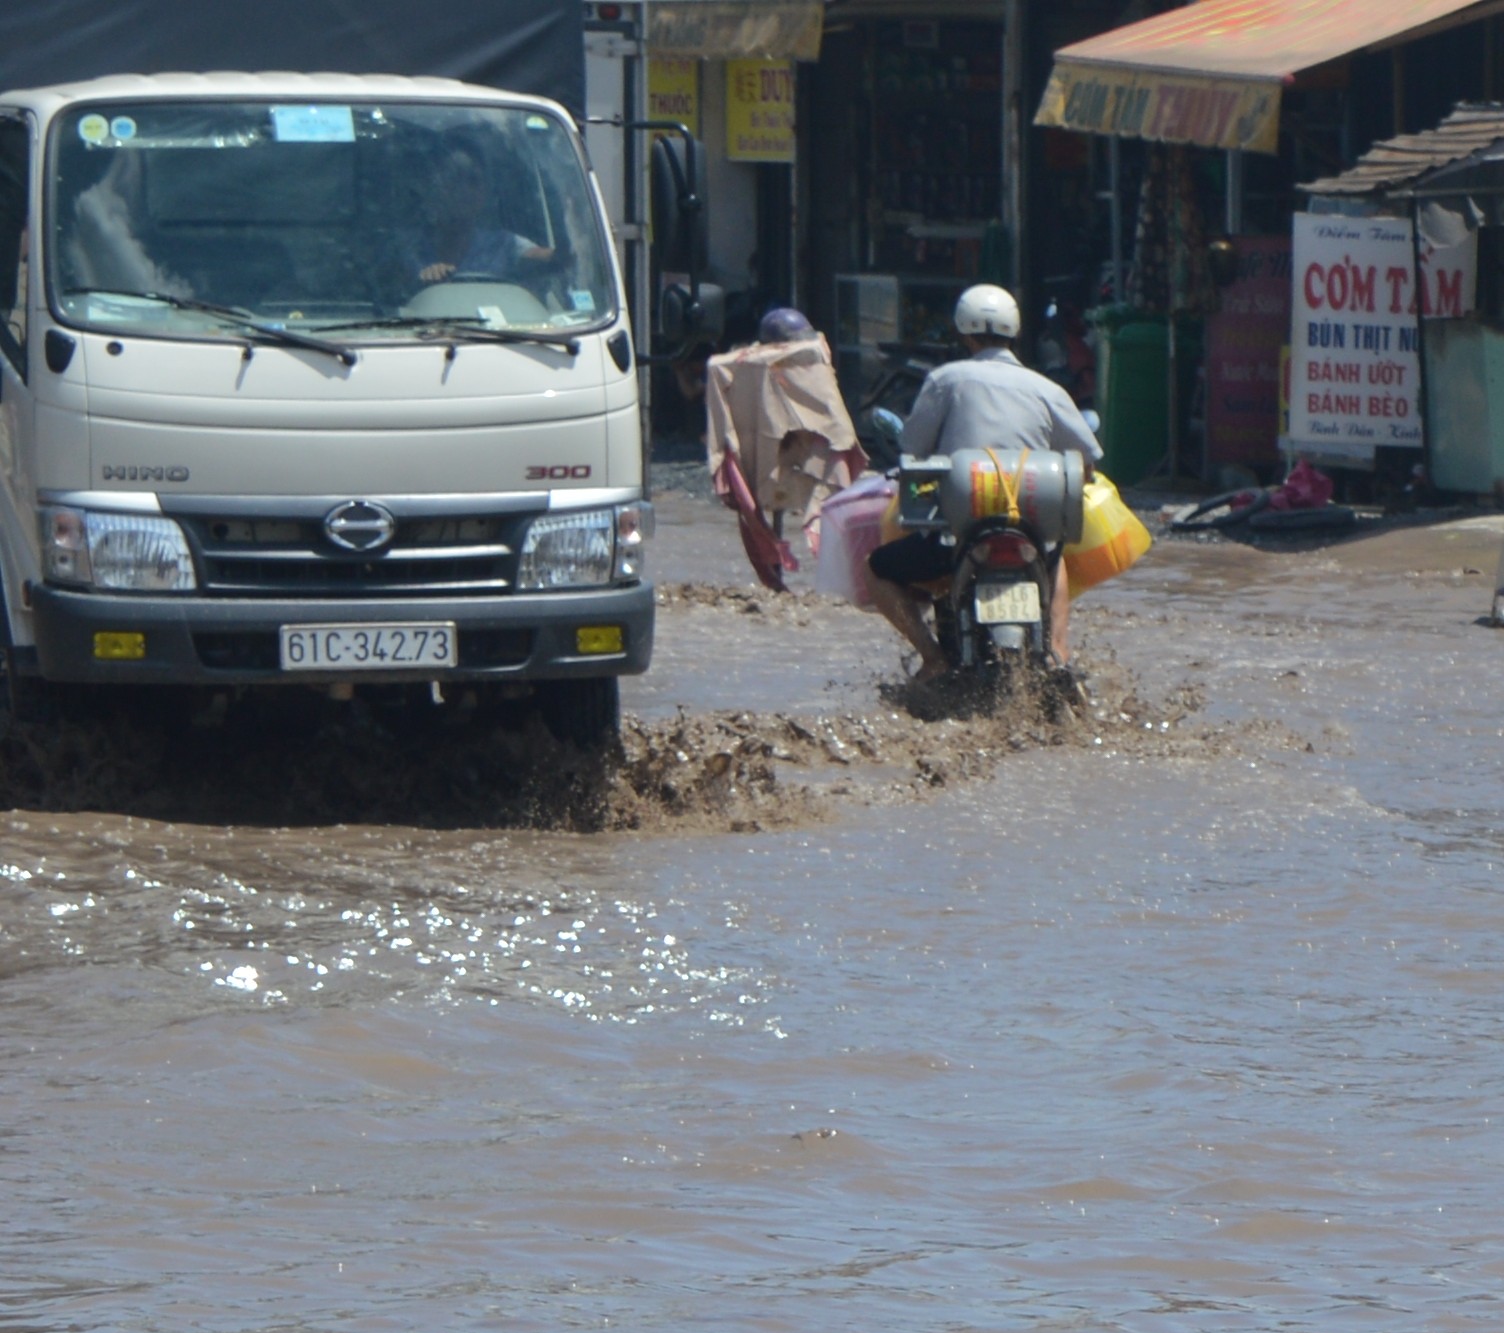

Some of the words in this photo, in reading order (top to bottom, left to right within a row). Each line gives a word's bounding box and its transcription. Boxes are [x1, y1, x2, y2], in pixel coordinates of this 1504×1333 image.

[1303, 254, 1377, 313] CƠM
[1307, 319, 1345, 349] BÚN
[1353, 324, 1392, 356] THỊT
[1307, 357, 1361, 384] BÁNH
[1307, 388, 1361, 416] BÁNH
[1368, 391, 1408, 418] BÈO
[102, 464, 190, 482] HINO
[525, 464, 592, 480] 300
[288, 629, 449, 663] 61C-342.73
